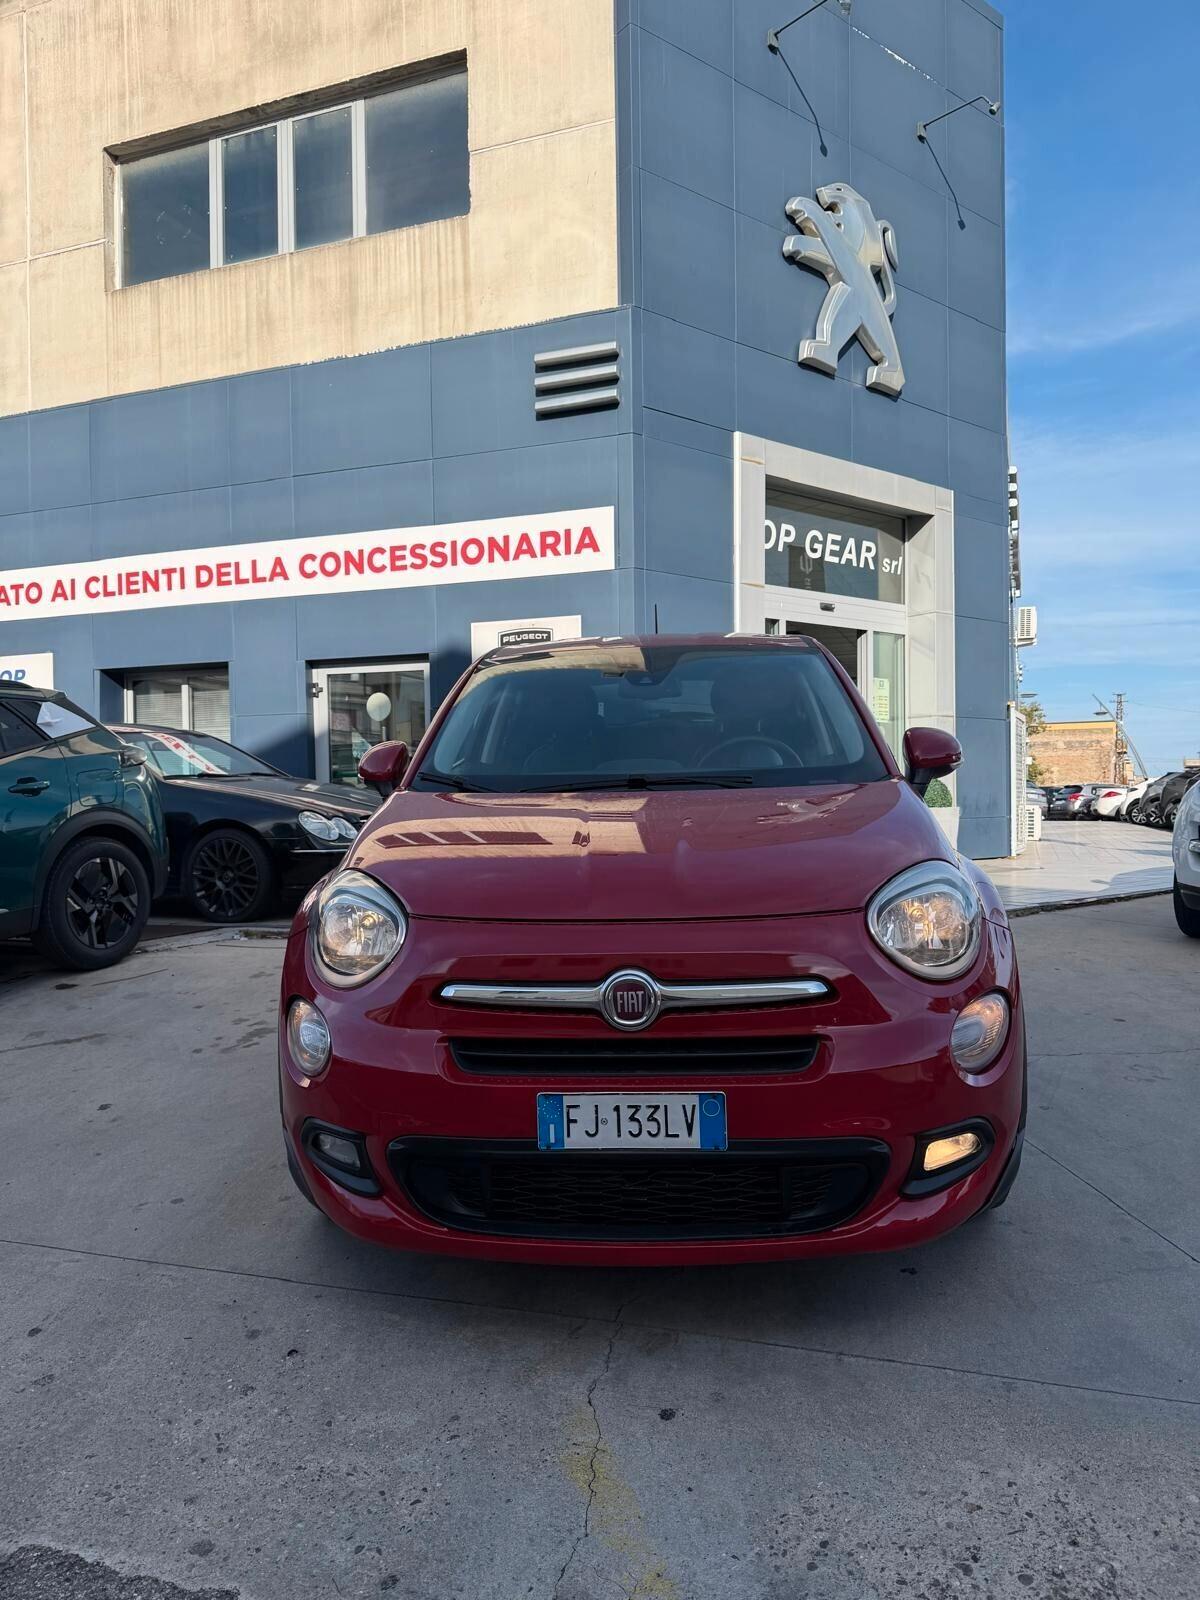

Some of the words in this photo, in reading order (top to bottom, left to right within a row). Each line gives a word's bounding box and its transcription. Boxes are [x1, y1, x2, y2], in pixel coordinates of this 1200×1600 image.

[0, 581, 43, 606] ATO
[51, 578, 76, 602] AI
[84, 567, 186, 600] CLIENTI
[194, 556, 289, 588] DELLA
[298, 526, 600, 580] CONCESSIONARIA
[804, 529, 877, 570] GEAR
[881, 556, 903, 575] srl
[502, 632, 549, 644] PEUGEOT
[616, 990, 645, 1013] FIAT
